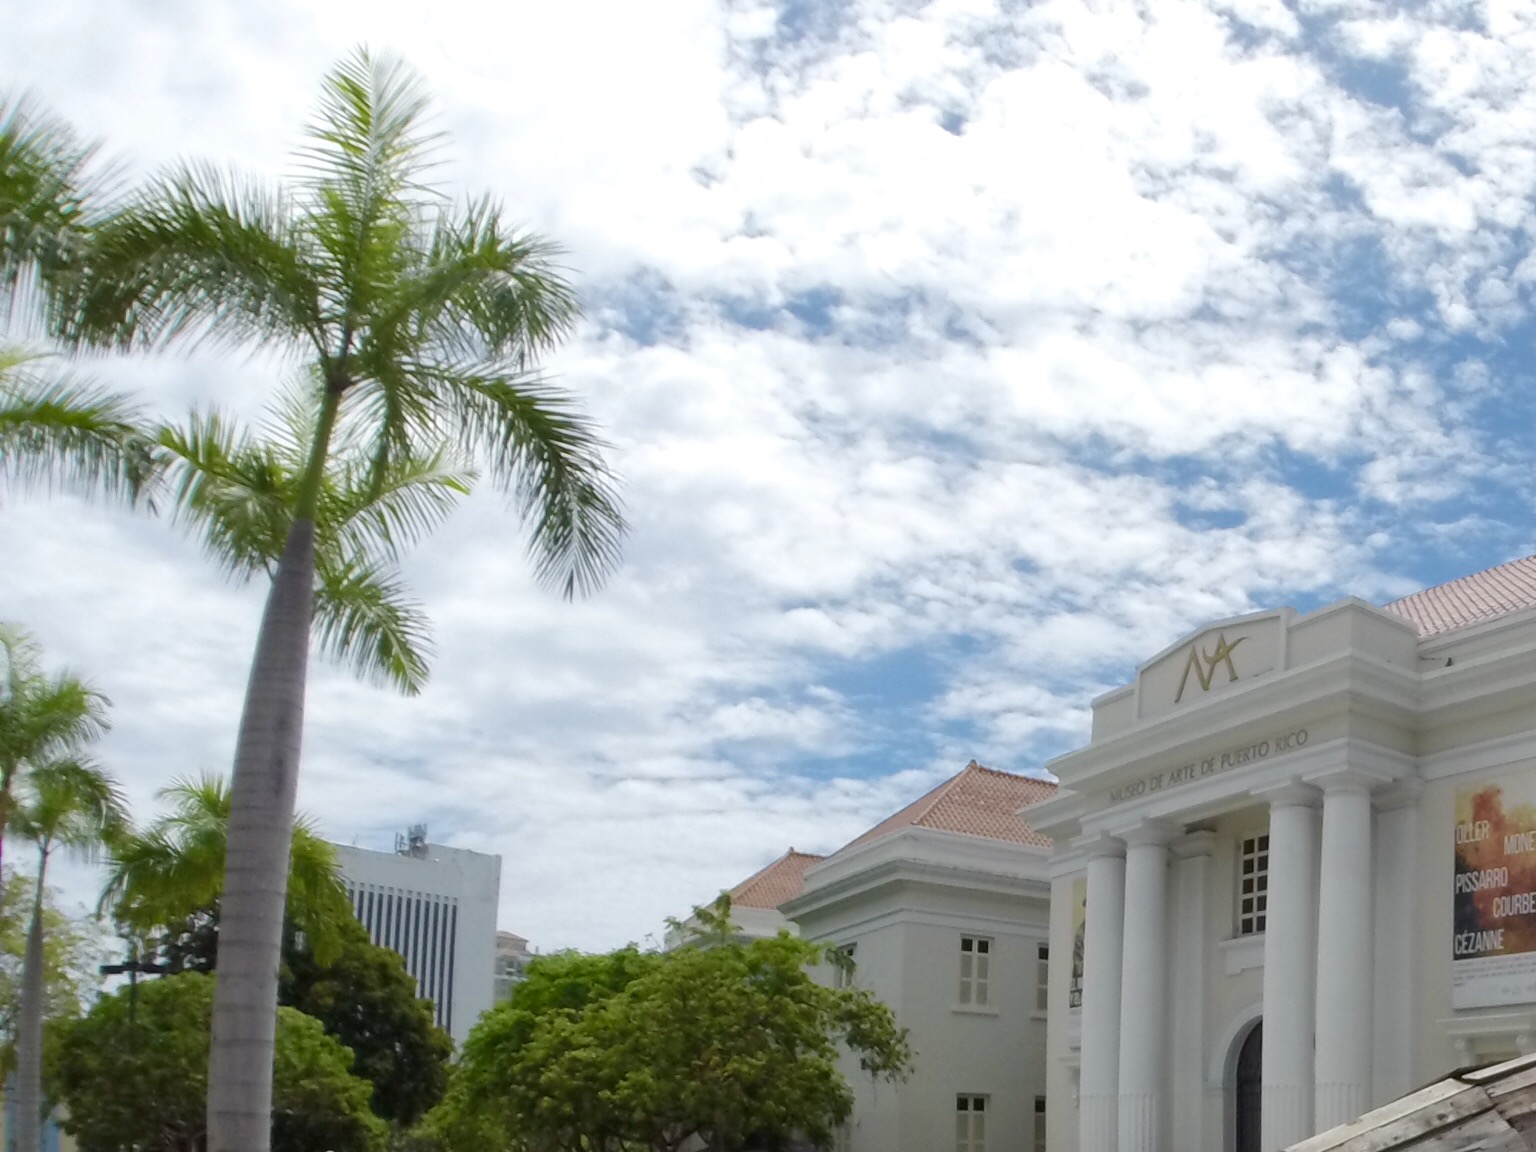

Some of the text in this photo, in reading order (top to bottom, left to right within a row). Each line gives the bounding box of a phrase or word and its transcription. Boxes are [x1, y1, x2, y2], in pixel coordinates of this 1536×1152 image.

[1110, 729, 1310, 802] MUSEO DE ARTE DE PUERTO RICO
[1456, 819, 1490, 844] OLLER
[1455, 866, 1509, 894] PISSARRO
[1454, 929, 1505, 955] CÉZANNE
